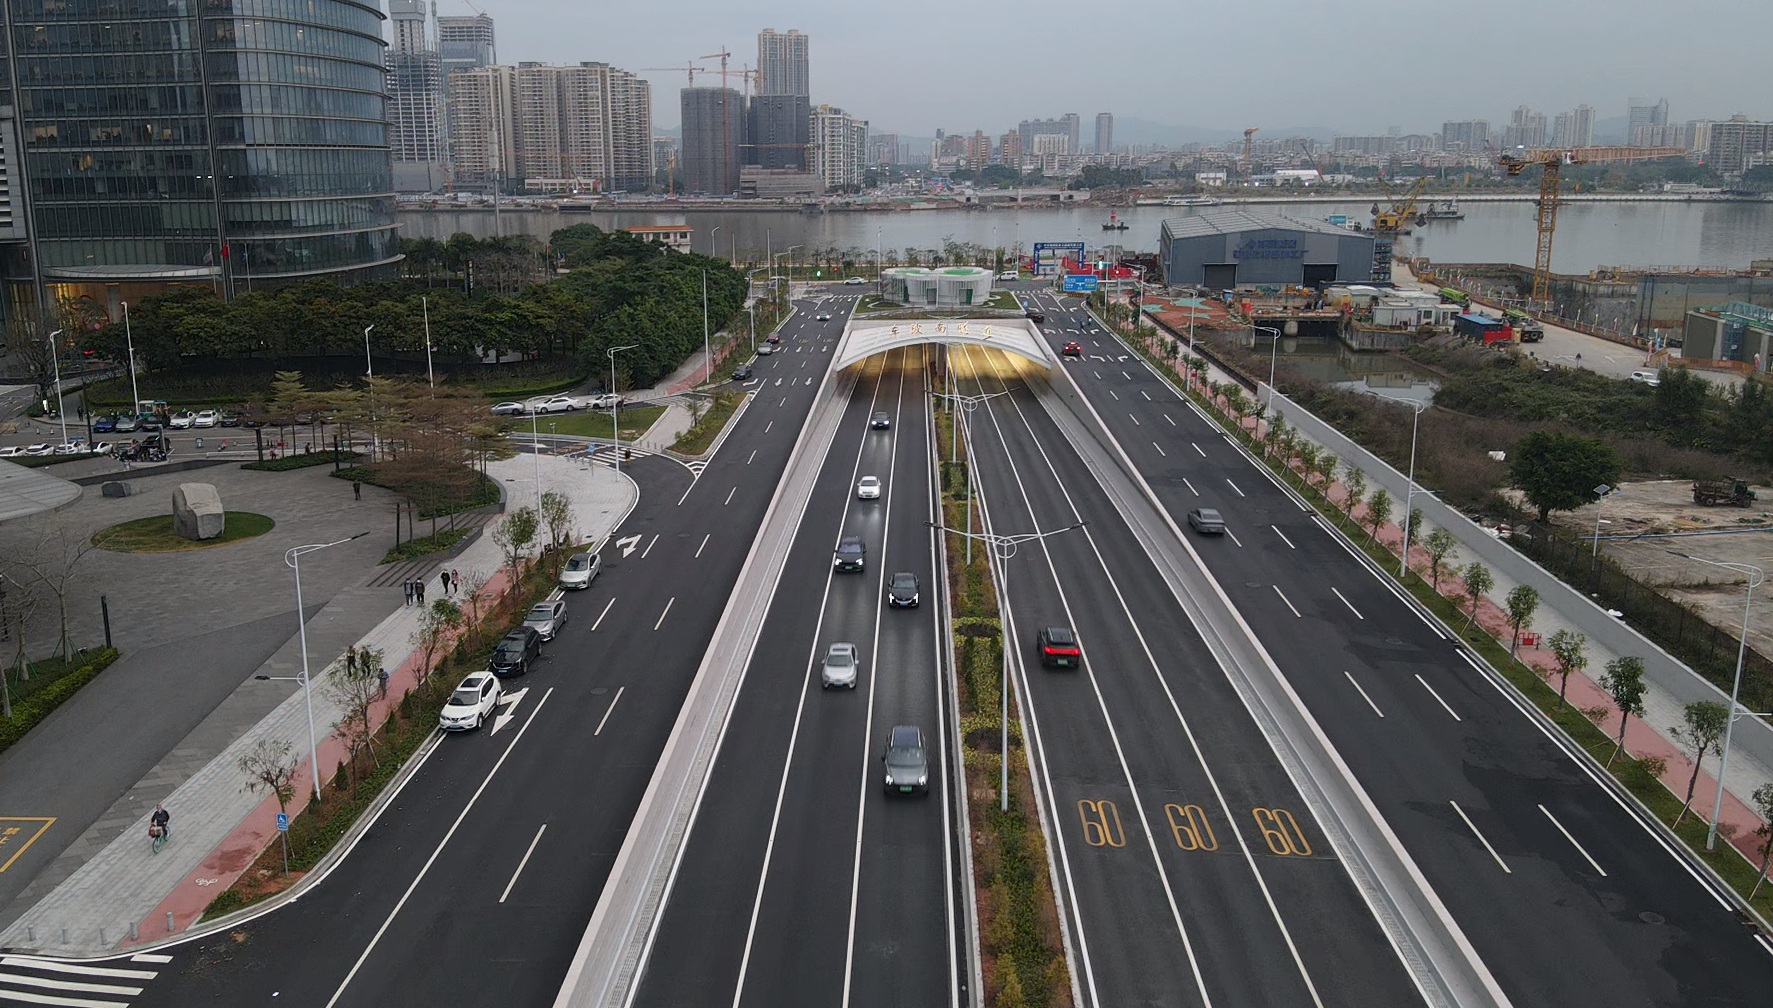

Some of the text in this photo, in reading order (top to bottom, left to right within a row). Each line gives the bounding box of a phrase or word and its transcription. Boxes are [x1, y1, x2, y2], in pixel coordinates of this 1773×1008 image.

[1077, 799, 1127, 848] 60
[1164, 803, 1219, 852] 60
[1251, 807, 1312, 856] 60
